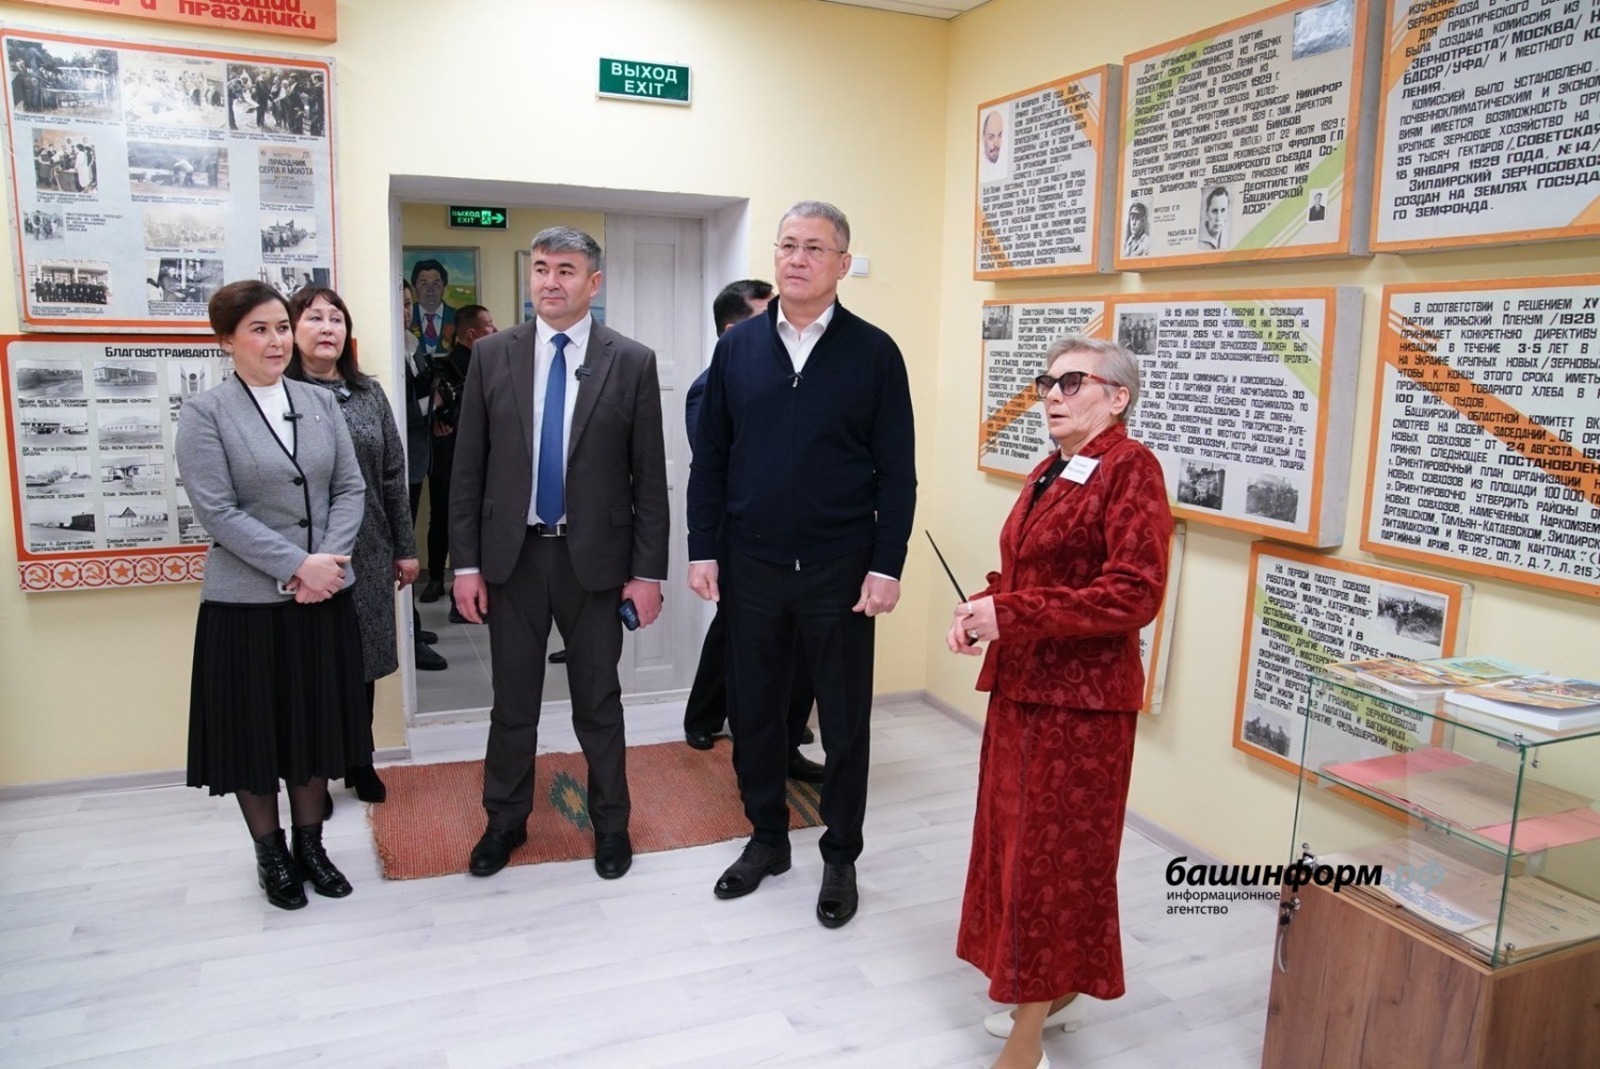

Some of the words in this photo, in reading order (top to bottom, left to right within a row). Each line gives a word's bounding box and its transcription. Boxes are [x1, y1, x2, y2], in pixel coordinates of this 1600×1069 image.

[1405, 42, 1431, 57] БЫЛА
[1439, 27, 1483, 48] СОЗДАНА
[1493, 8, 1551, 33] КОМИССИЯ
[1563, 0, 1580, 15] ИЗ
[1418, 26, 1438, 41] ДЛЯ
[1447, 0, 1529, 31] ПРАКТИЧЕСКОГО
[1499, 50, 1507, 62] И
[1515, 33, 1574, 58] МЕСТНОГО
[611, 62, 677, 84] ВЫХОД
[1251, 73, 1272, 86] 1929
[624, 80, 664, 95] EXIT
[1296, 81, 1342, 99] НИКИФОР
[1412, 90, 1465, 109] КОМИССИЕЙ
[1474, 81, 1504, 97] БЫЛО
[1400, 90, 1531, 125] ПОЧВЕННОКЛИМАТИЧЕСКИМ
[1541, 86, 1550, 97] И
[1266, 115, 1301, 130] БИКБОВ
[1399, 126, 1423, 140] ВИЯМ
[1430, 116, 1473, 133] ИМЕЕТСЯ
[1485, 99, 1567, 123] ВОЗМОЖНОСТЬ
[1288, 134, 1326, 148] ФРОЛОВ
[1398, 137, 1435, 153] КРУПНОЕ
[1443, 128, 1491, 145] ЗЕРНОВОЕ
[1500, 114, 1563, 135] ХОЗЯЙСТВО
[1574, 109, 1589, 122] НА
[1212, 154, 1270, 174] БАШКИРСКОГО
[1276, 149, 1312, 163] СЪЕЗДА
[1397, 155, 1412, 166] 35
[1418, 149, 1450, 162] ТЫСЯЧ
[1413, 161, 1459, 177] ЯНВАРЯ
[1469, 155, 1500, 169] 1929
[1409, 170, 1491, 191] ЗИЛАИРСКИЙ
[1130, 187, 1153, 197] ВЕТОВ
[1243, 181, 1303, 208] БАШКИРСКОЙ
[1394, 192, 1440, 207] СОЗДАН
[1448, 188, 1465, 200] НА
[1474, 181, 1526, 197] ЗЕМЛЯХ
[452, 210, 480, 218] ВЫХОД
[1392, 209, 1407, 220] ГО
[1415, 200, 1493, 217] ЗЕМФОНДА.
[1413, 301, 1420, 313] В
[1427, 301, 1493, 313] СООТВЕТСТВИИ
[1503, 300, 1510, 311] С
[1518, 298, 1572, 310] РЕШЕНИЕМ
[1276, 319, 1294, 328] 385
[1401, 316, 1434, 326] ПАРТИИ
[1444, 314, 1492, 326] ИЮНЬСКИЙ
[1502, 313, 1543, 325] ПЛЕНУМ
[1193, 329, 1208, 338] 265
[1460, 328, 1522, 339] КОНКРЕТНУЮ
[1534, 328, 1597, 340] ДИРЕКТИВУ
[1464, 342, 1500, 353] ТЕЧЕНИЕ
[1548, 342, 1568, 354] ЛЕТ
[1580, 342, 1589, 354] В
[1414, 354, 1449, 366] УКРАИНЕ
[1457, 356, 1496, 367] КРУПНЫХ
[1506, 357, 1538, 368] НОВЫХ
[1446, 369, 1474, 380] КОНЦУ
[1483, 370, 1513, 381] ЭТОГО
[1521, 371, 1553, 382] СРОКА
[1292, 390, 1305, 399] 30
[1395, 393, 1414, 403] 100
[1470, 383, 1522, 395] ТОВАРНОГО
[1531, 386, 1564, 397] ХЛЕБА
[1577, 388, 1585, 398] В
[1404, 405, 1460, 419] БАШКИРСКИЙ
[1467, 411, 1519, 423] ОБЛАСТНОЙ
[1527, 415, 1574, 427] КОМИТЕТ
[1392, 418, 1429, 431] СМОТРЕВ
[1437, 422, 1448, 432] НА
[1455, 423, 1485, 435] СВОЕМ
[1493, 426, 1546, 440] ЗАСЕДАНИИ
[1390, 443, 1421, 455] ПРИНЯЛ
[1430, 447, 1487, 463] СЛЕДУЮЩЕЕ
[1391, 431, 1418, 442] НОВЫХ
[1484, 439, 1497, 449] ОТ
[1506, 441, 1525, 452] 24
[1530, 443, 1572, 456] АВГУСТА
[1387, 468, 1414, 480] НОВЫХ
[1421, 472, 1463, 487] СОВХОЗОВ
[1470, 478, 1483, 489] ИЗ
[1490, 480, 1537, 497] ПЛОЩАДИ
[1480, 466, 1503, 478] ПЛАН
[1513, 470, 1582, 491] ОРГАНИЗАЦИИ
[1469, 506, 1529, 523] НАМЕЧЕННЫХ
[1476, 493, 1528, 509] УТВЕРДИТЬ
[1536, 501, 1578, 516] РАЙОНЫ
[1457, 529, 1520, 549] МЕСЯГУТСКОМ
